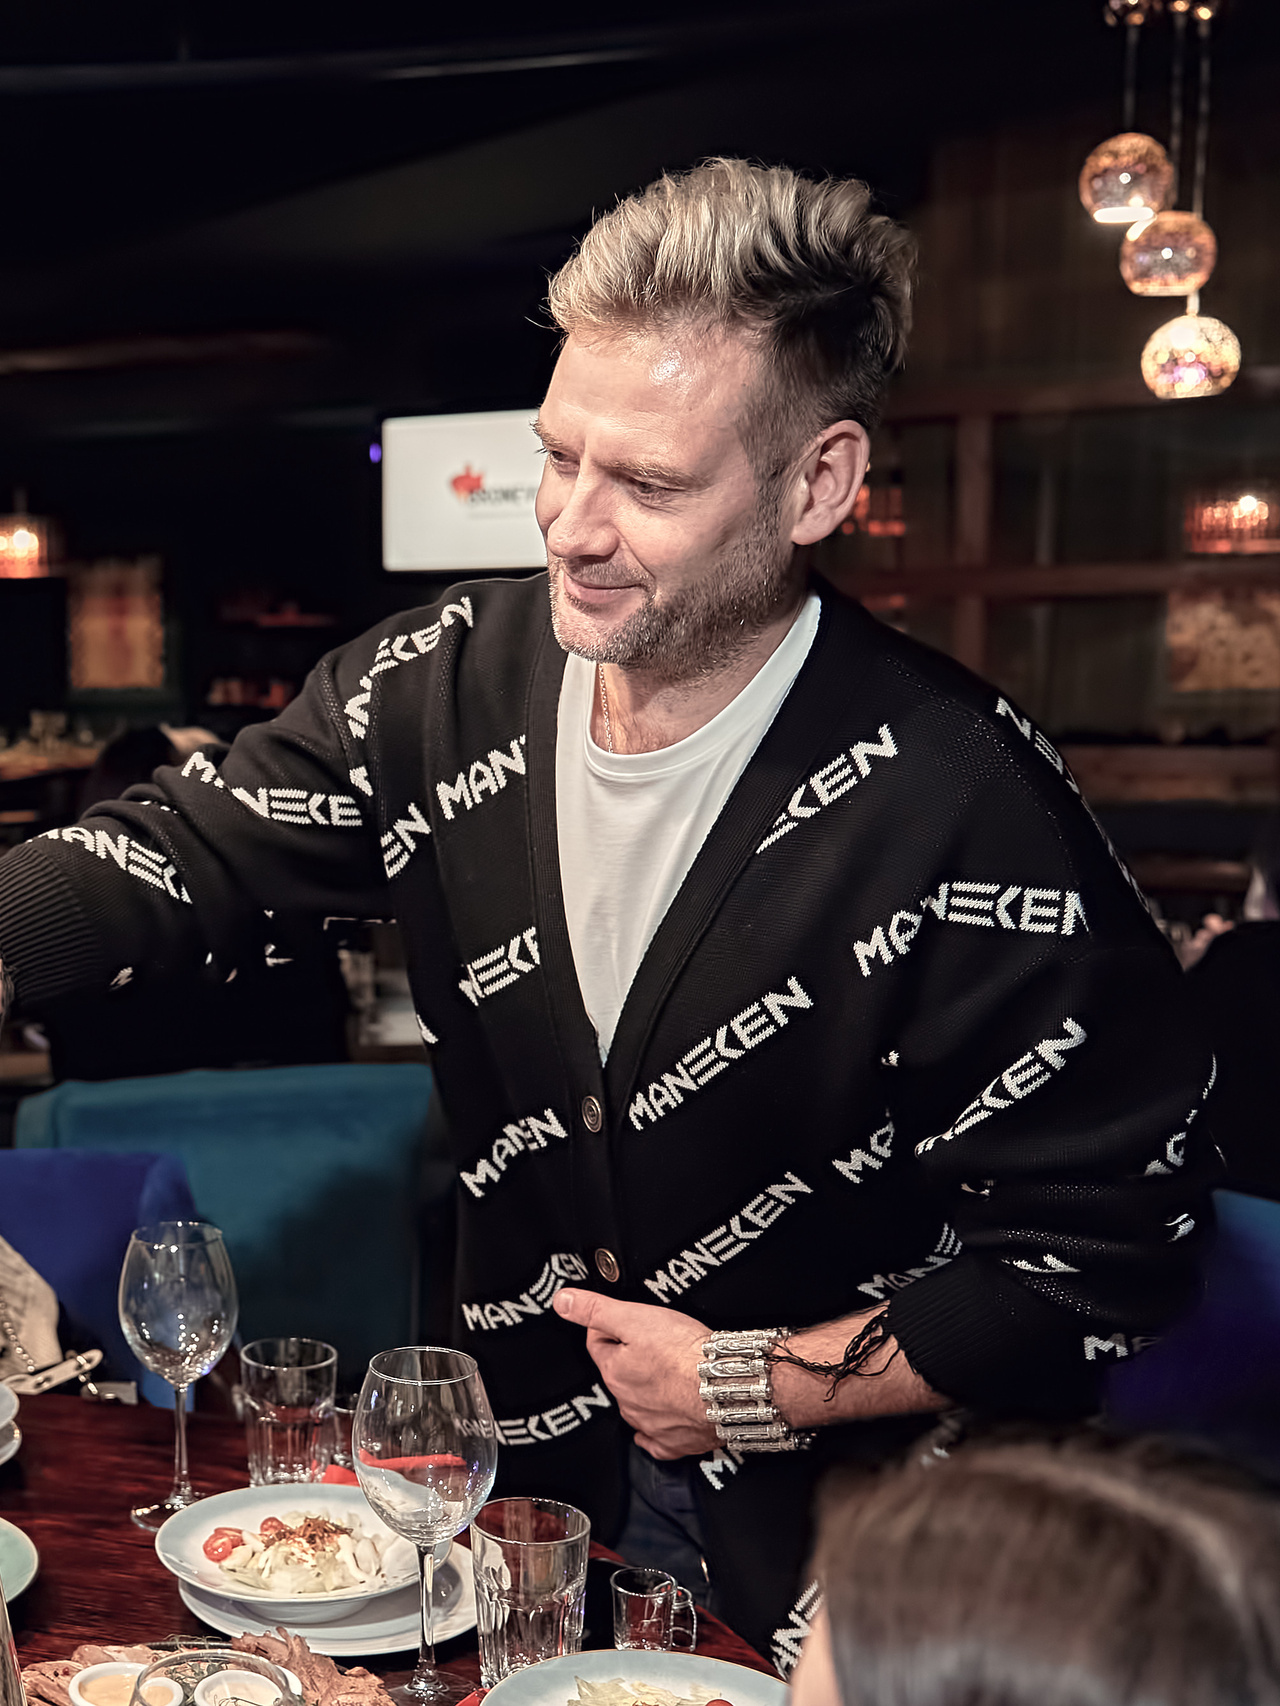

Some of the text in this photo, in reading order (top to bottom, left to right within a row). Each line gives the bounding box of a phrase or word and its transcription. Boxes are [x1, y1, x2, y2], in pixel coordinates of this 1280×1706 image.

[628, 976, 813, 1131] MANEKEN
[461, 1253, 589, 1331] MANEKEN
[644, 1172, 813, 1304] MANEKEN
